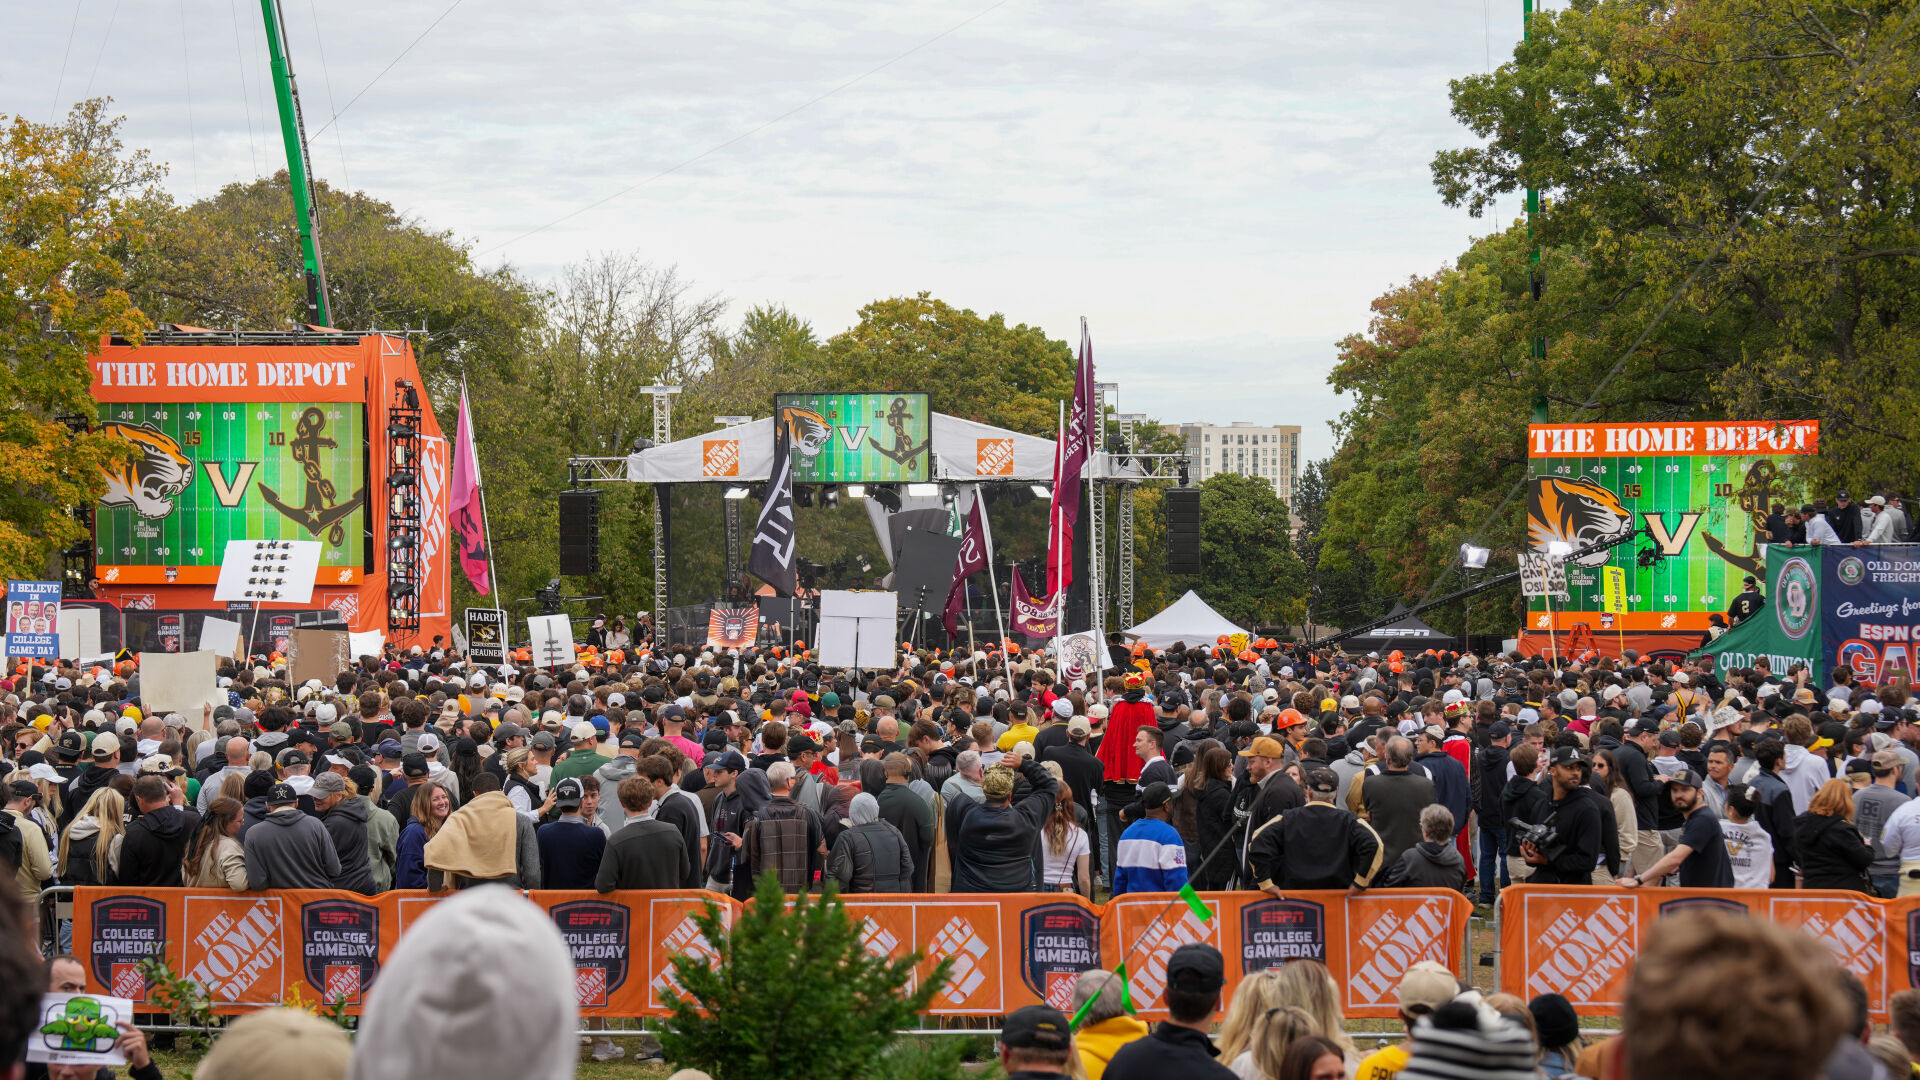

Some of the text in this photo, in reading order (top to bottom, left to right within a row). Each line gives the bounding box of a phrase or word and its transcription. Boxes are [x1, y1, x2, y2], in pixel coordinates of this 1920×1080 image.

[97, 362, 351, 387] THE HOME DEPOT
[184, 431, 201, 446] 15
[268, 431, 285, 446] 10
[837, 426, 869, 451] V
[1530, 426, 1811, 453] THE HOME DEPOT
[706, 443, 721, 459] THE
[977, 438, 1014, 475] HOME
[979, 442, 997, 457] THE
[703, 440, 739, 476] HOME
[200, 462, 259, 507] V
[1623, 484, 1641, 498] 15
[1714, 483, 1732, 497] 10
[1867, 561, 1892, 571] OLD
[10, 584, 59, 594] I BELIEVE
[1741, 600, 1750, 614] 2
[1837, 601, 1899, 618] Greetings
[1370, 628, 1430, 637] ESPN
[1860, 623, 1909, 641] ESPN
[12, 636, 52, 645] COLLEGE
[9, 646, 55, 655] GAME DAY
[1719, 652, 1745, 671] OLD
[1569, 748, 1580, 759] A
[109, 908, 148, 920] ESPN
[319, 912, 360, 925] ESPN
[569, 913, 611, 926] ESPN
[1261, 911, 1304, 923] ESPN
[102, 928, 155, 940] COLLEGE
[194, 909, 236, 952] THE
[313, 930, 368, 943] COLLEGE
[1131, 914, 1171, 957] THE
[1359, 908, 1404, 951] THE
[1537, 907, 1583, 951] THE
[1253, 931, 1312, 944] COLLEGE
[93, 941, 163, 955] GAMEDAY
[185, 899, 282, 1000] HOME
[305, 943, 376, 958] GAMEDAY
[1244, 943, 1323, 959] GAMEDAY
[1351, 898, 1449, 1004] HOME
[1528, 896, 1635, 996] HOME
[115, 967, 128, 981] THE
[219, 937, 283, 1002] DEPOT
[329, 969, 342, 985] THE
[1570, 937, 1636, 1003] DEPOT
[325, 965, 361, 1004] HOME
[1050, 977, 1065, 992] THE
